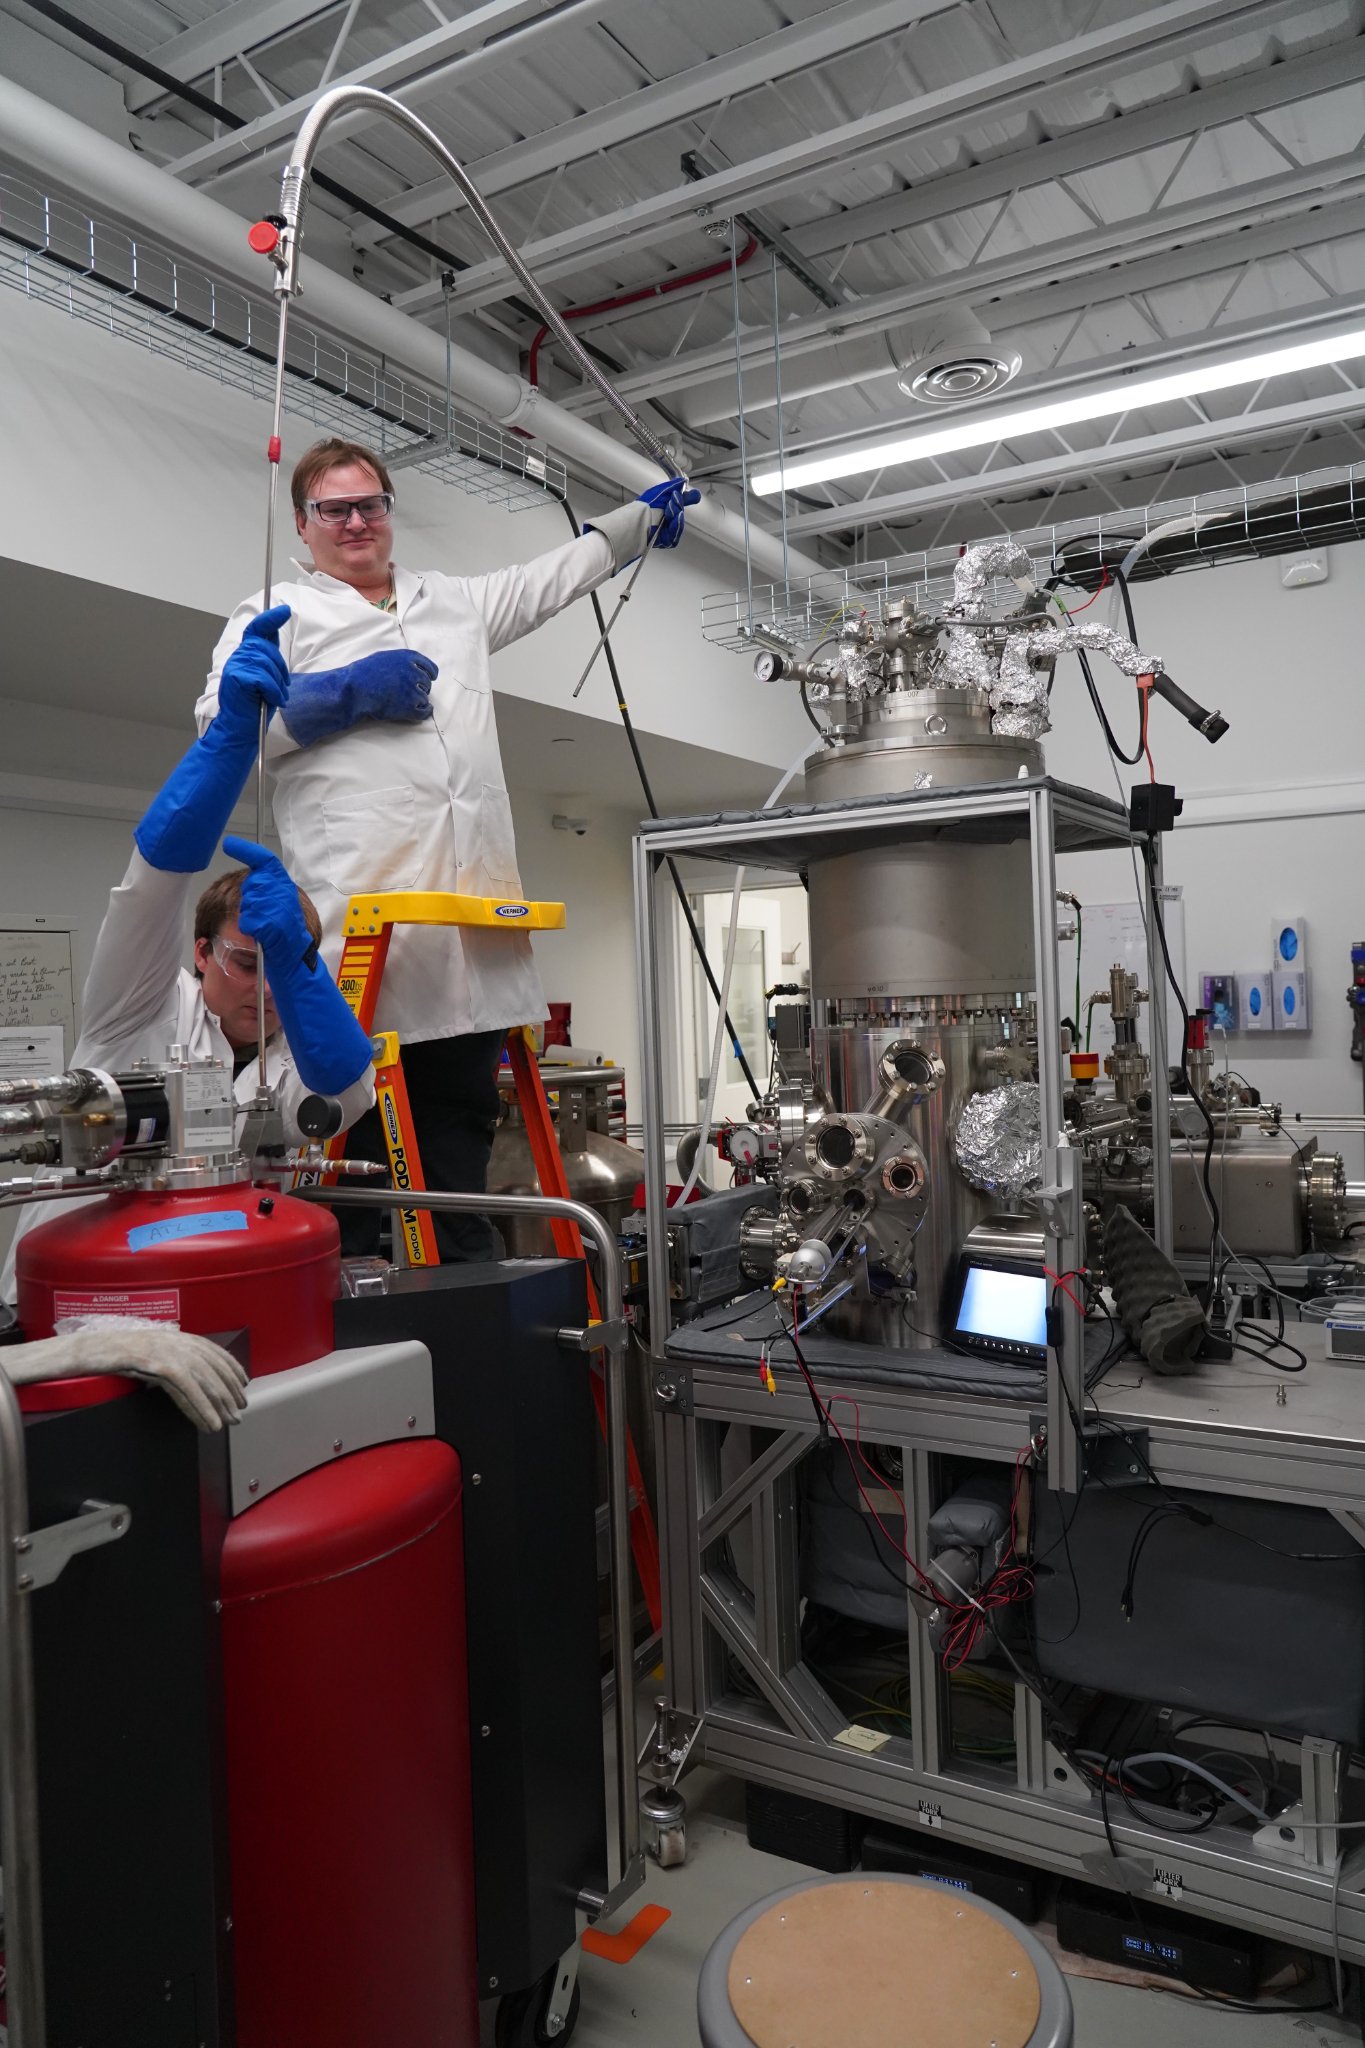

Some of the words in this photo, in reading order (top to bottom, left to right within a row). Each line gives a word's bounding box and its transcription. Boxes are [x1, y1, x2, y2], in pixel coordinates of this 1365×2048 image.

[340, 979, 356, 991] 300
[386, 1102, 397, 1135] WERNER
[409, 1226, 421, 1260] PODIO
[99, 1295, 129, 1303] DANGER
[920, 1800, 940, 1811] LIFTER
[922, 1807, 939, 1817] FORK
[1157, 1869, 1181, 1882] LIFTER
[1159, 1876, 1179, 1887] FORK
